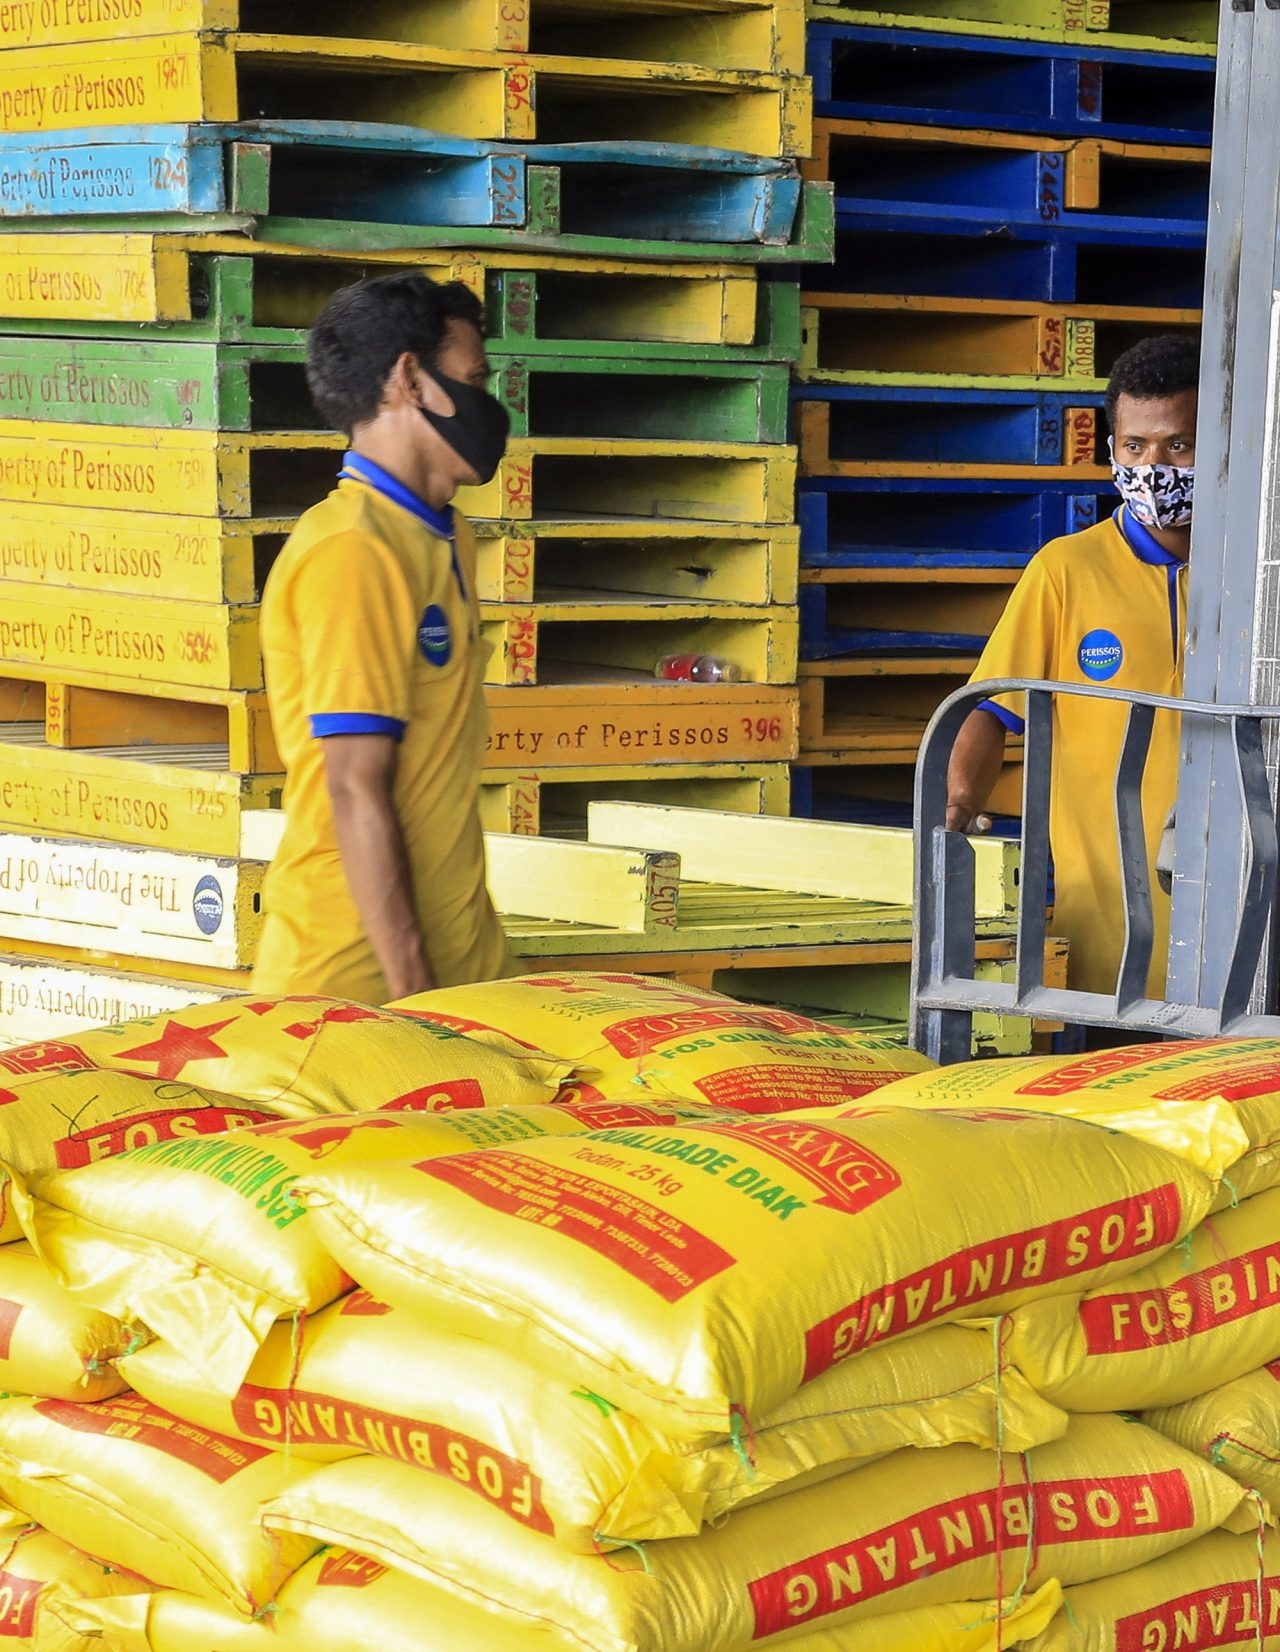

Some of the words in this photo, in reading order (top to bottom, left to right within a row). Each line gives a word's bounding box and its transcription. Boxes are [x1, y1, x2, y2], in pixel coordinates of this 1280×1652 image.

[74, 74, 145, 112] Perissos
[47, 448, 67, 489] of
[73, 450, 156, 494] Perissos
[81, 532, 162, 579] Perissos
[54, 613, 76, 652] of
[80, 616, 166, 662] Perissos
[1081, 646, 1121, 657] PERISSOS
[557, 725, 589, 749] of
[601, 723, 730, 748] Perissos
[740, 717, 783, 742] 396
[79, 780, 169, 831] Perissos
[15, 858, 40, 893] of
[46, 853, 132, 906] Property
[140, 875, 181, 912] The
[618, 1010, 706, 1044] FOS
[659, 1038, 716, 1061] FOS
[1036, 1058, 1124, 1090] FOS
[1091, 1071, 1149, 1091] FOS
[570, 1146, 630, 1172] Todan:
[627, 1163, 659, 1183] 25
[656, 1173, 685, 1197] kg
[725, 1166, 808, 1222] DIAK
[1069, 1202, 1157, 1271] FOS
[830, 1243, 1044, 1361] BINTANG
[1111, 1288, 1194, 1343] FOS
[254, 1397, 433, 1470] BINTANG
[447, 1442, 533, 1519] FOS
[1053, 1485, 1157, 1536] FOS
[784, 1494, 1030, 1618] BINTANG
